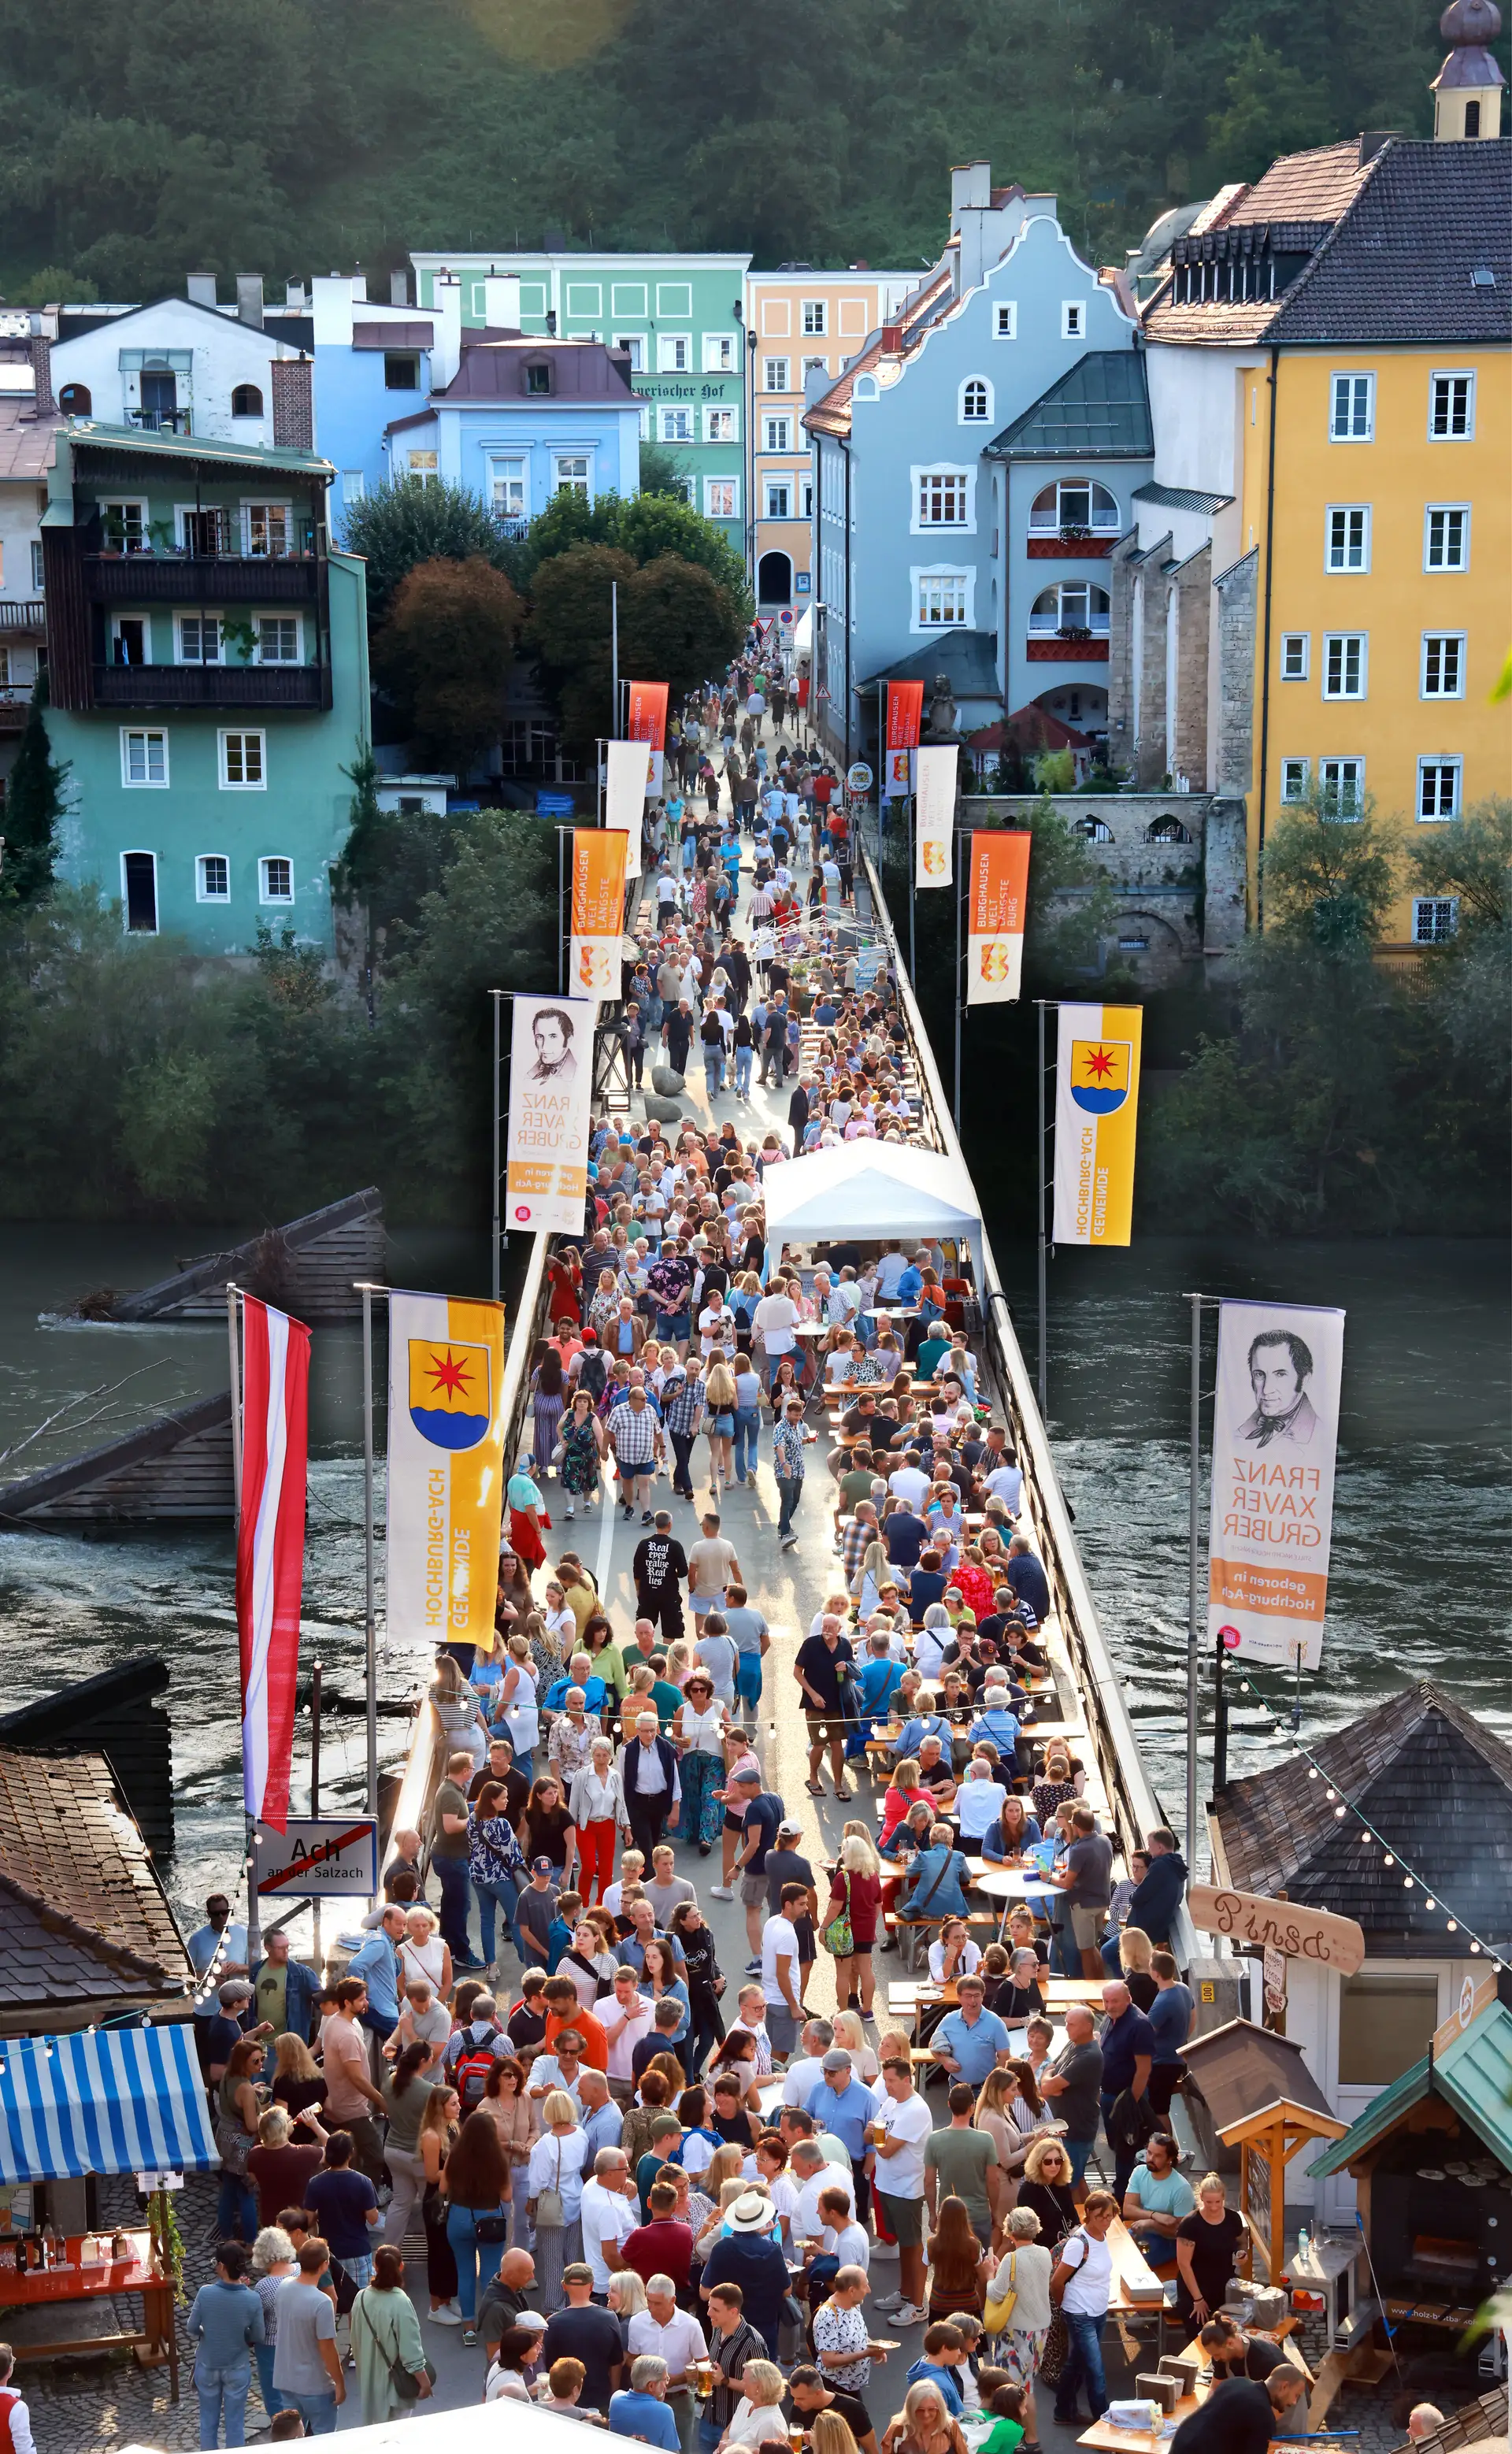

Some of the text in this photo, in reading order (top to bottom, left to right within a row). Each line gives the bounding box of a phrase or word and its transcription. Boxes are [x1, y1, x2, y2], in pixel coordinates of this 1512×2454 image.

[701, 384, 725, 399] Hof
[578, 850, 589, 929] BURGHAUSEN
[977, 854, 989, 928] BURGHAUSEN
[587, 899, 598, 929] WELT
[608, 898, 618, 929] BURG
[988, 899, 999, 928] WELT
[1007, 898, 1017, 927] BURG
[647, 1541, 669, 1552] Real
[649, 1551, 667, 1560] eyes
[646, 1559, 669, 1570] realize
[647, 1566, 666, 1577] Real
[648, 1575, 662, 1585] lies
[291, 1838, 340, 1862] Ach
[268, 1867, 363, 1878] an der Salzach
[1214, 1892, 1330, 1961] Pinsa
[1203, 1987, 1213, 2000] 001
